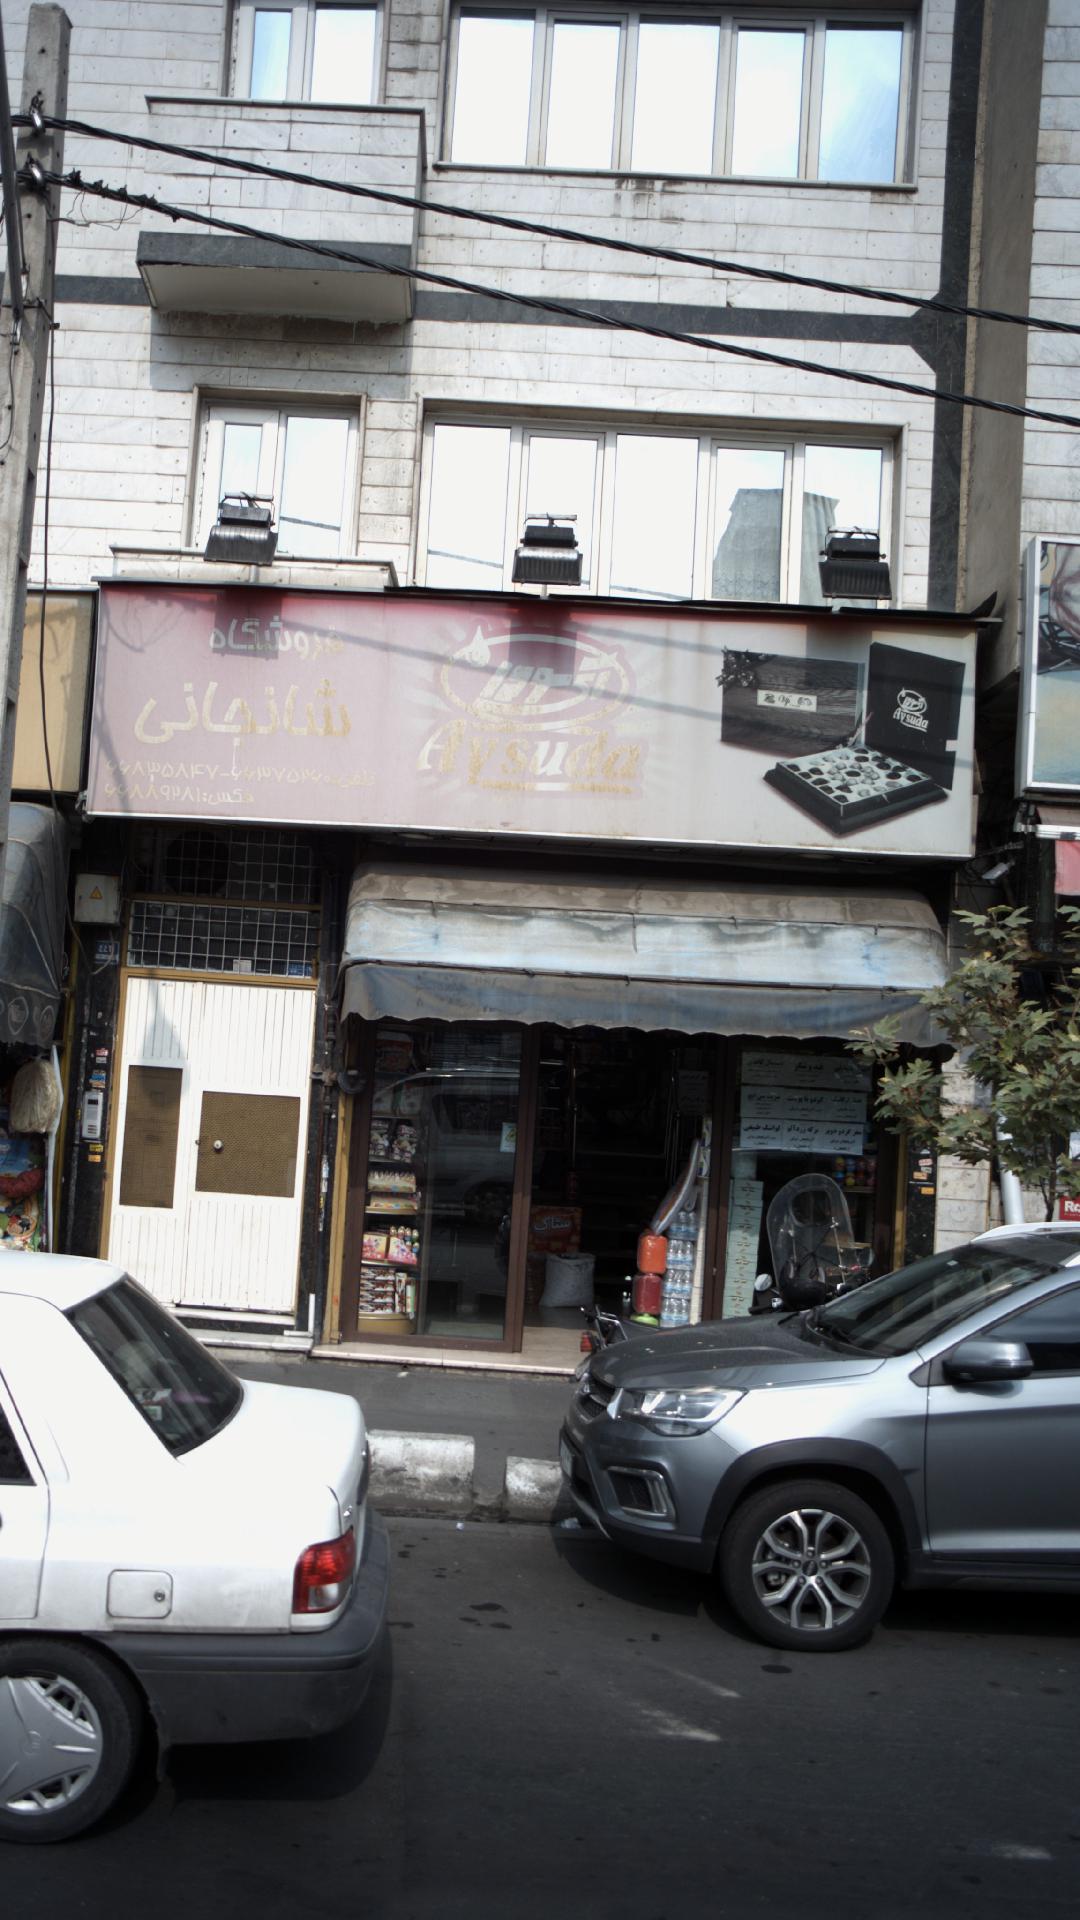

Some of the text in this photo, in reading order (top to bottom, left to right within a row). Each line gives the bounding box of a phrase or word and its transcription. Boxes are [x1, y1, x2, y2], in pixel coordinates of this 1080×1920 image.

[209, 614, 346, 661] فروشگاه
[893, 708, 930, 731] Aysuda
[417, 719, 642, 786] Aysuda
